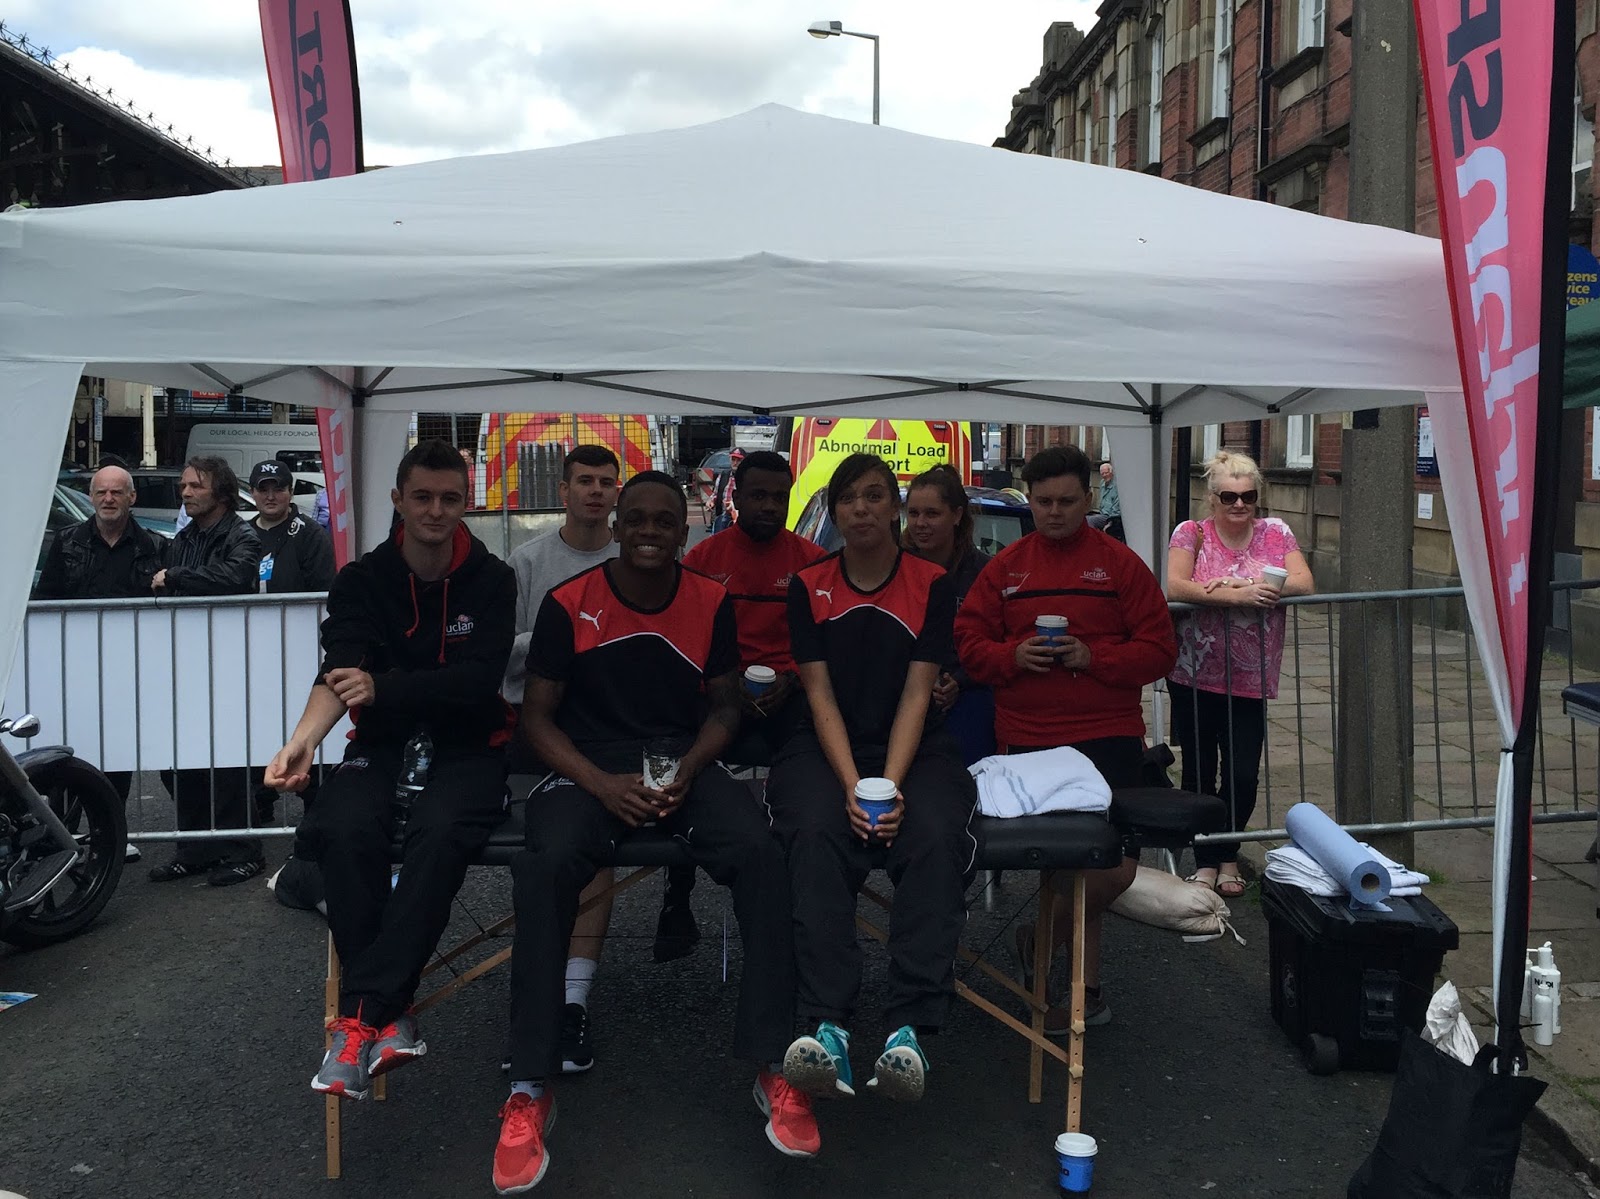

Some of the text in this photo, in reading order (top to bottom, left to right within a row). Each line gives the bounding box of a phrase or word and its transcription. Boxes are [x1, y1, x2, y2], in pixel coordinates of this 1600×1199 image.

[818, 438, 946, 459] Abnormal Load
[260, 463, 279, 474] NY
[1083, 570, 1107, 579] uclan
[445, 621, 474, 633] uclan
